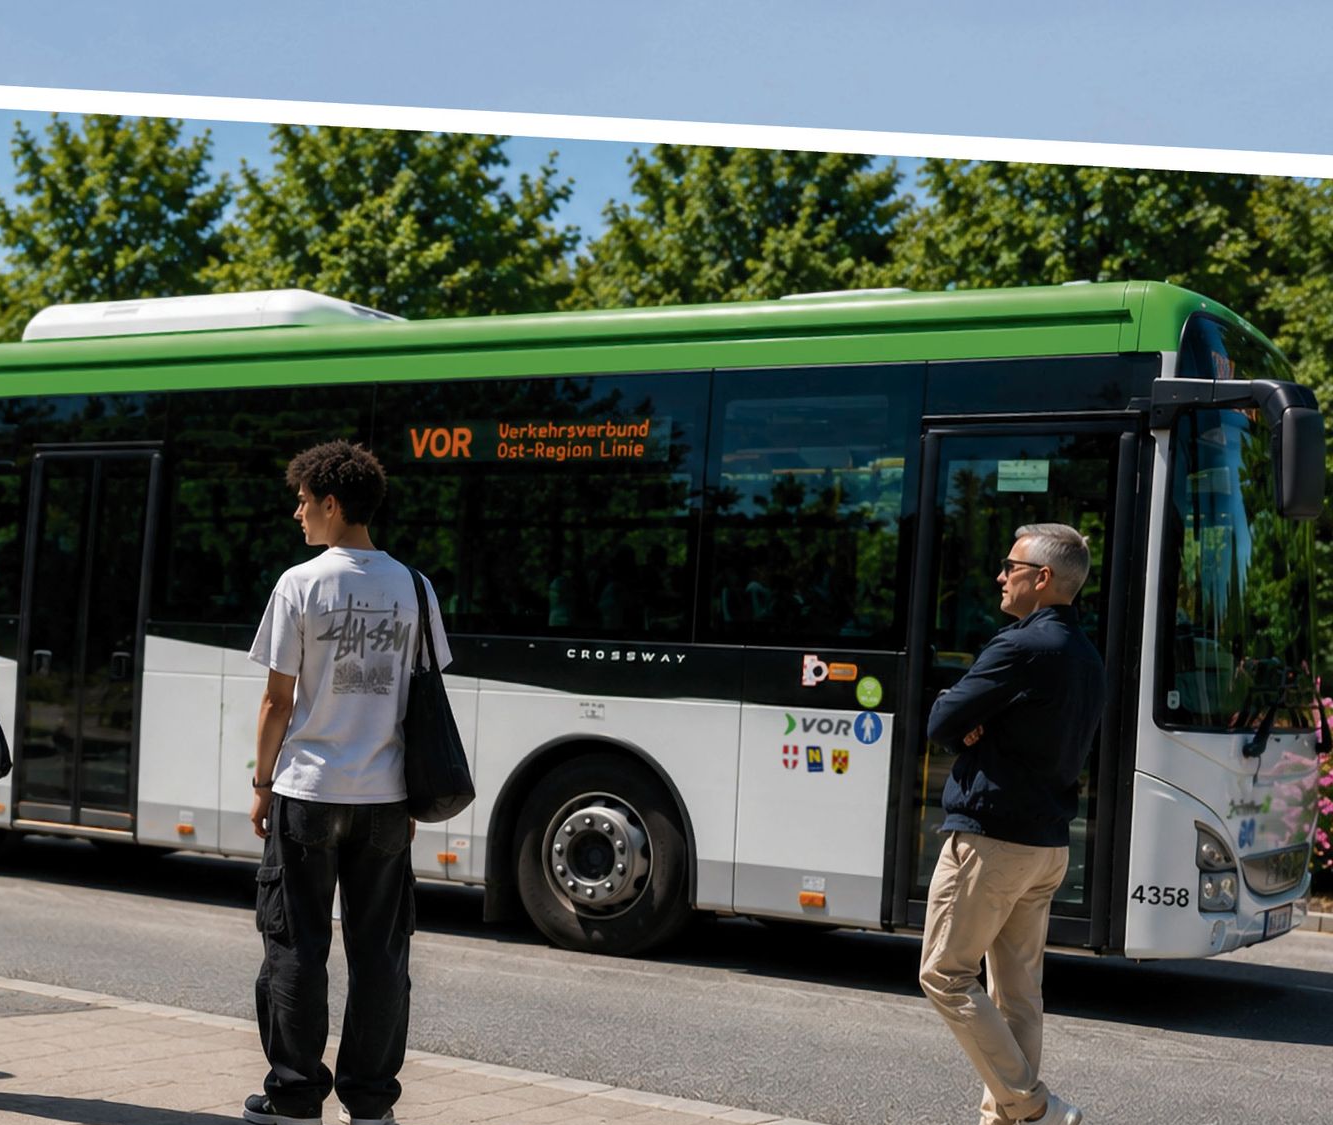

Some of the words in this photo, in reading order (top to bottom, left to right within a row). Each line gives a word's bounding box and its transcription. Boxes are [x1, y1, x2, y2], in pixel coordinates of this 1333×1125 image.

[498, 419, 650, 439] Verkehrsverbund
[409, 427, 472, 459] VOR
[497, 441, 592, 461] Ost-Region
[600, 440, 645, 458] Linie
[566, 649, 686, 663] CROSSWAY
[801, 717, 852, 736] VOR
[1131, 885, 1190, 908] 4358
